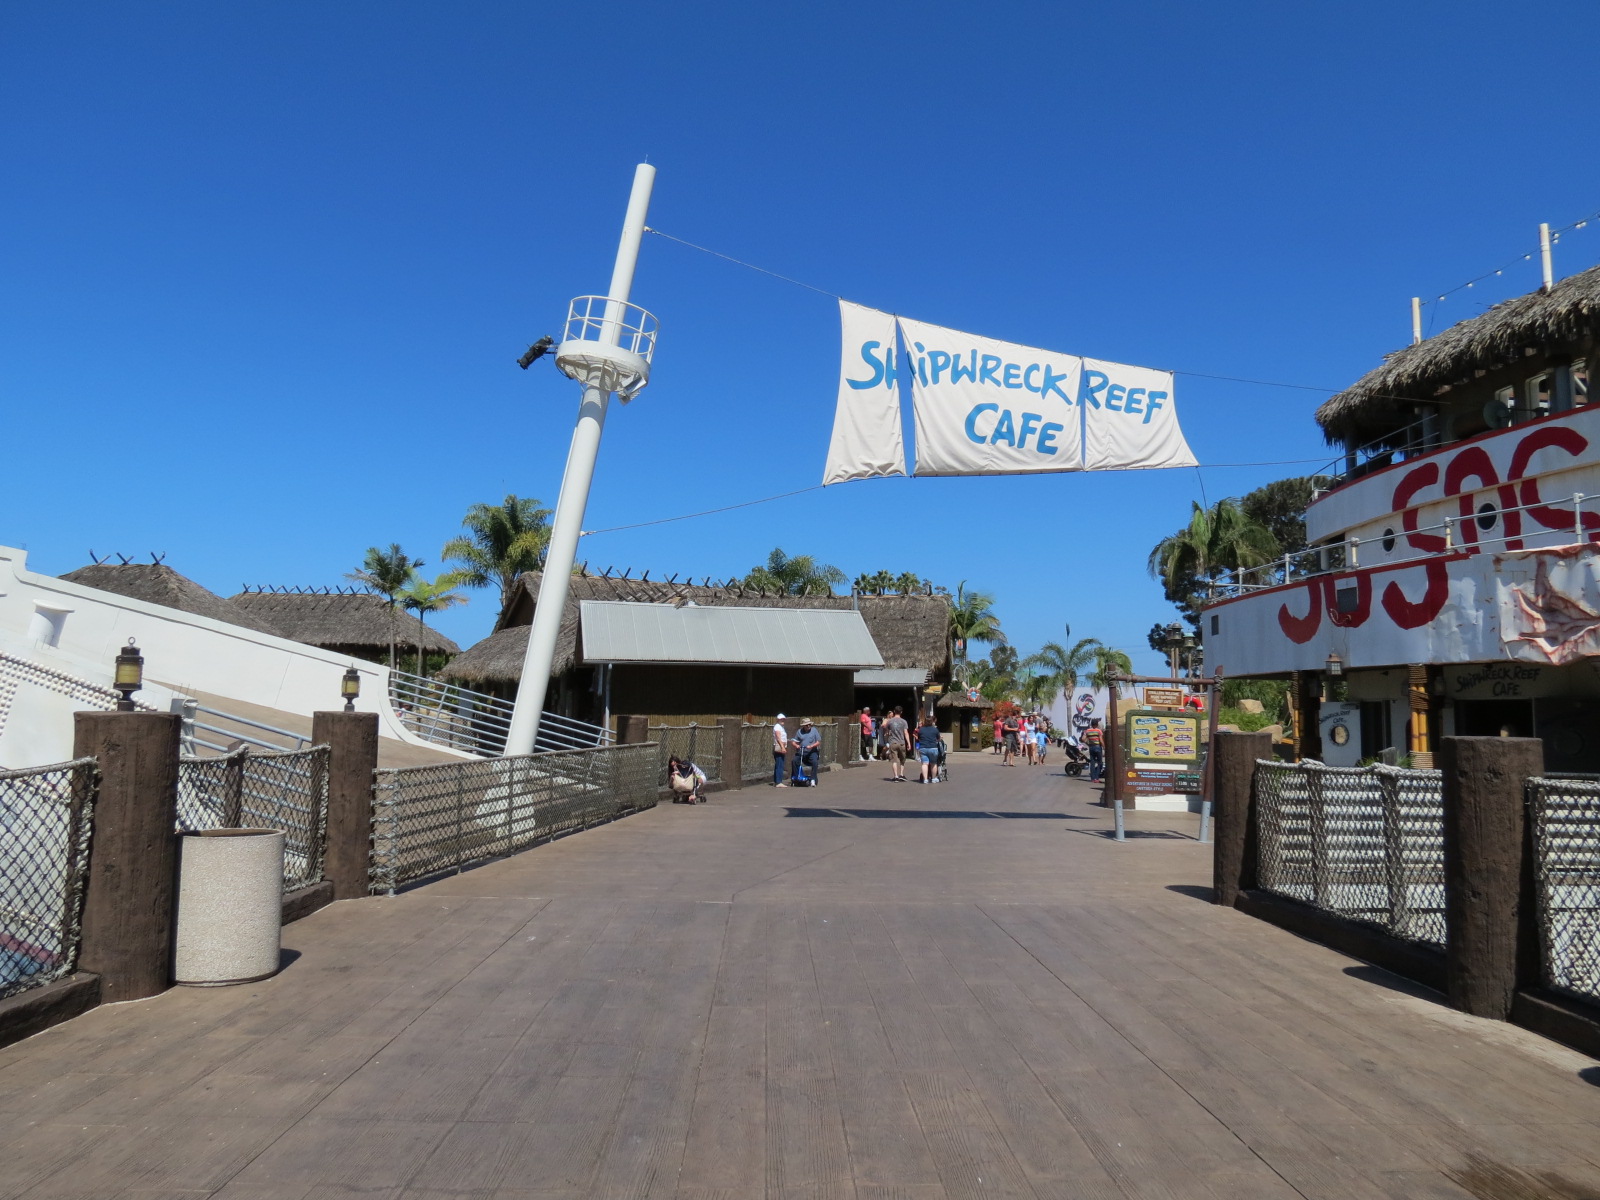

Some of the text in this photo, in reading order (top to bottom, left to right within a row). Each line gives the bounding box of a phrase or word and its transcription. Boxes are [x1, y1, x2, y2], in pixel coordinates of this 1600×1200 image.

[1084, 369, 1168, 425] REEF
[964, 402, 1064, 455] CAFE
[1492, 680, 1520, 697] CAFE
[1513, 665, 1541, 682] REEF
